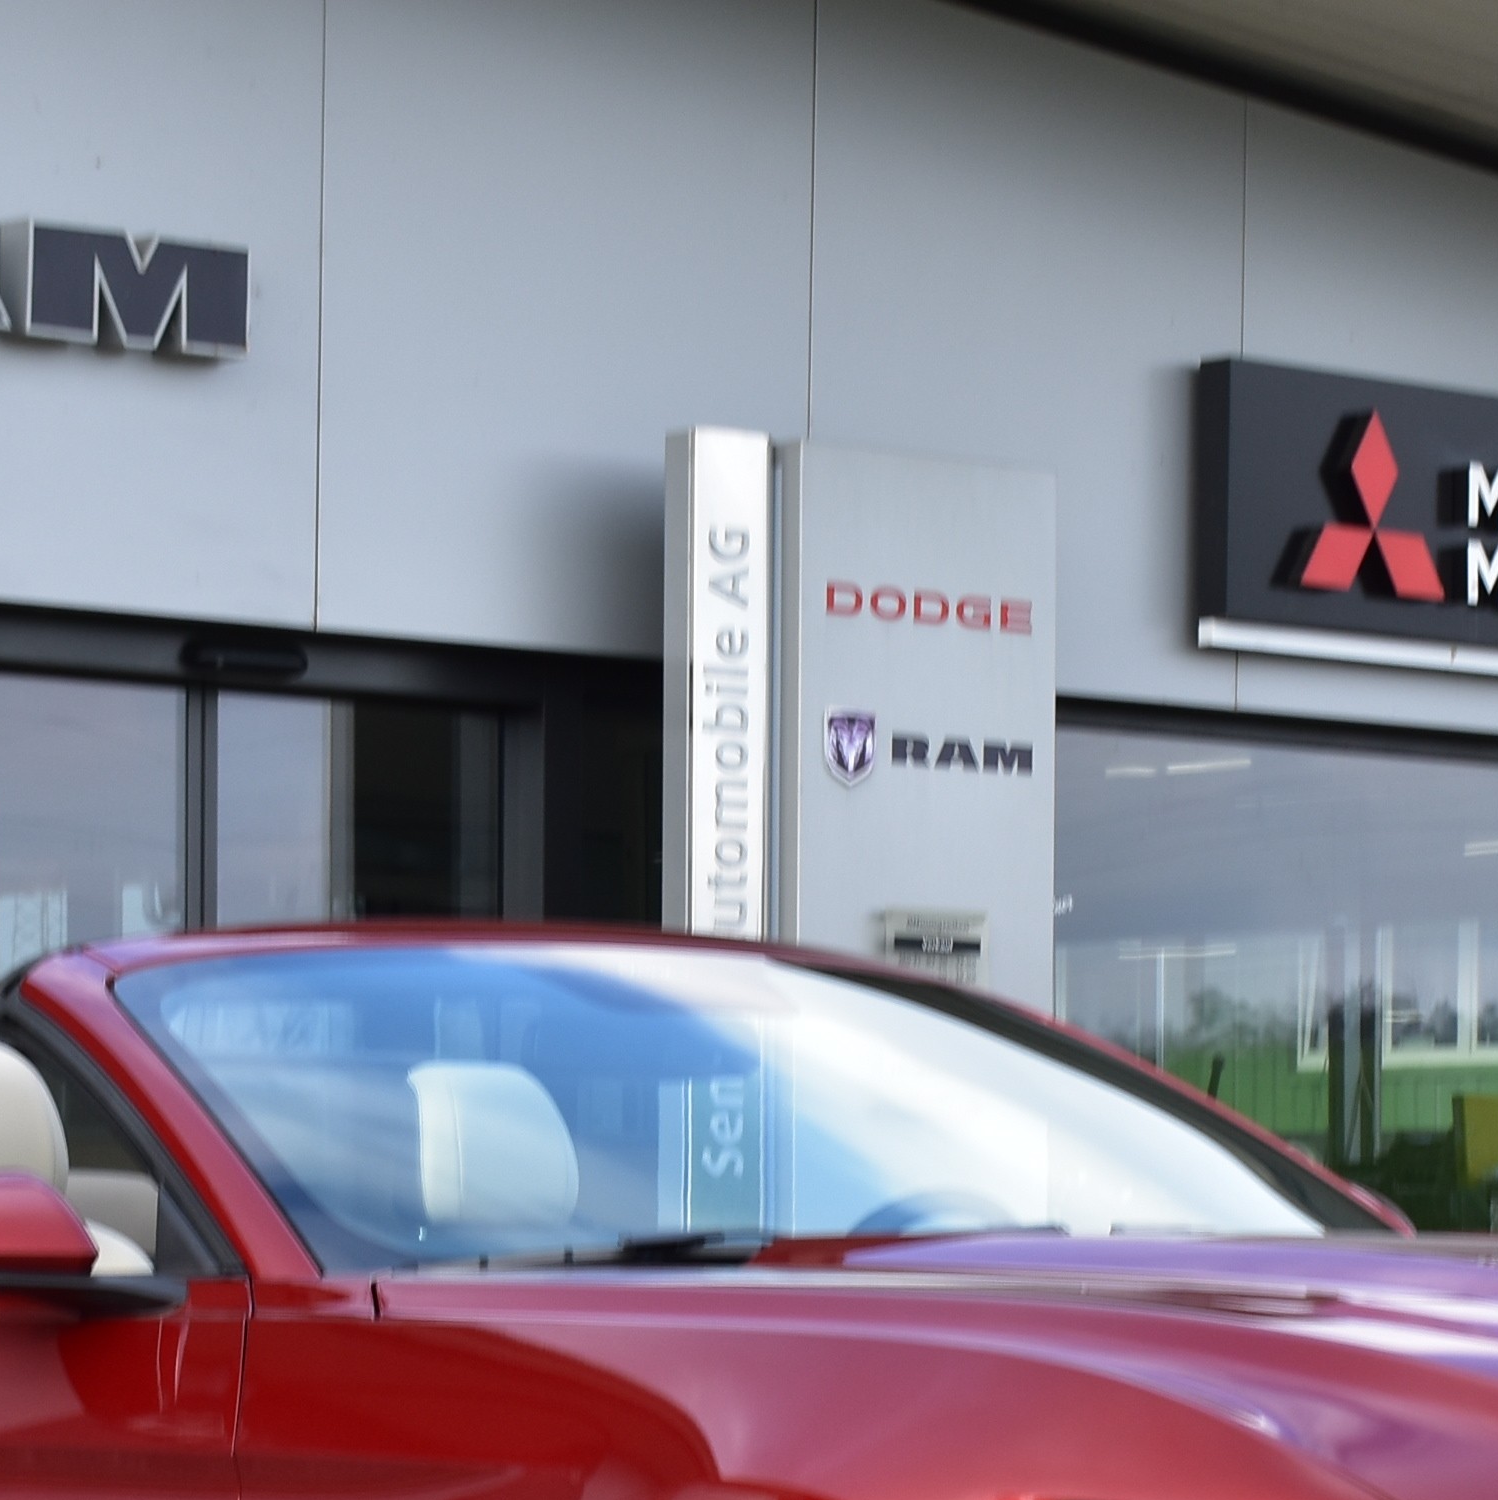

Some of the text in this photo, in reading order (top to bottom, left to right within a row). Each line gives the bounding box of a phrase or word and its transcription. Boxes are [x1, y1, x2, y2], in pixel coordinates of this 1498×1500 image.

[826, 580, 1032, 635] DODGE
[891, 731, 1033, 776] RAM
[702, 523, 750, 1180] Sen utomobile AG
